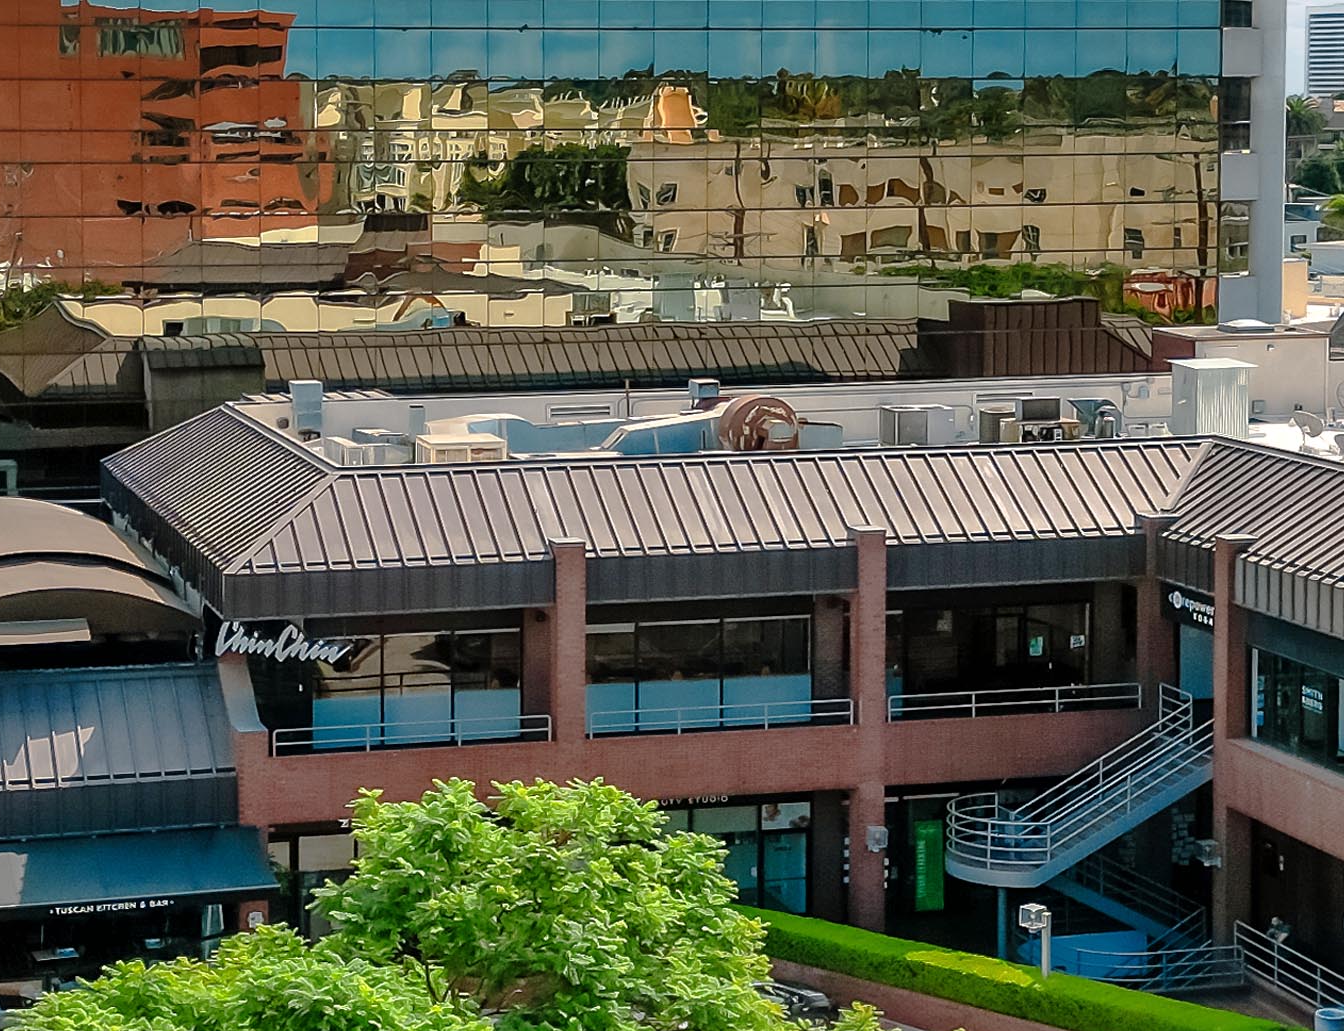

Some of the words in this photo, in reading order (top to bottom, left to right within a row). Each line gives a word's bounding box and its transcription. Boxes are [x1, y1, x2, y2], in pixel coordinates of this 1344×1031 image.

[56, 905, 94, 915] TUSCAN
[96, 902, 137, 912] KITCHEN
[149, 899, 169, 908] BAR
